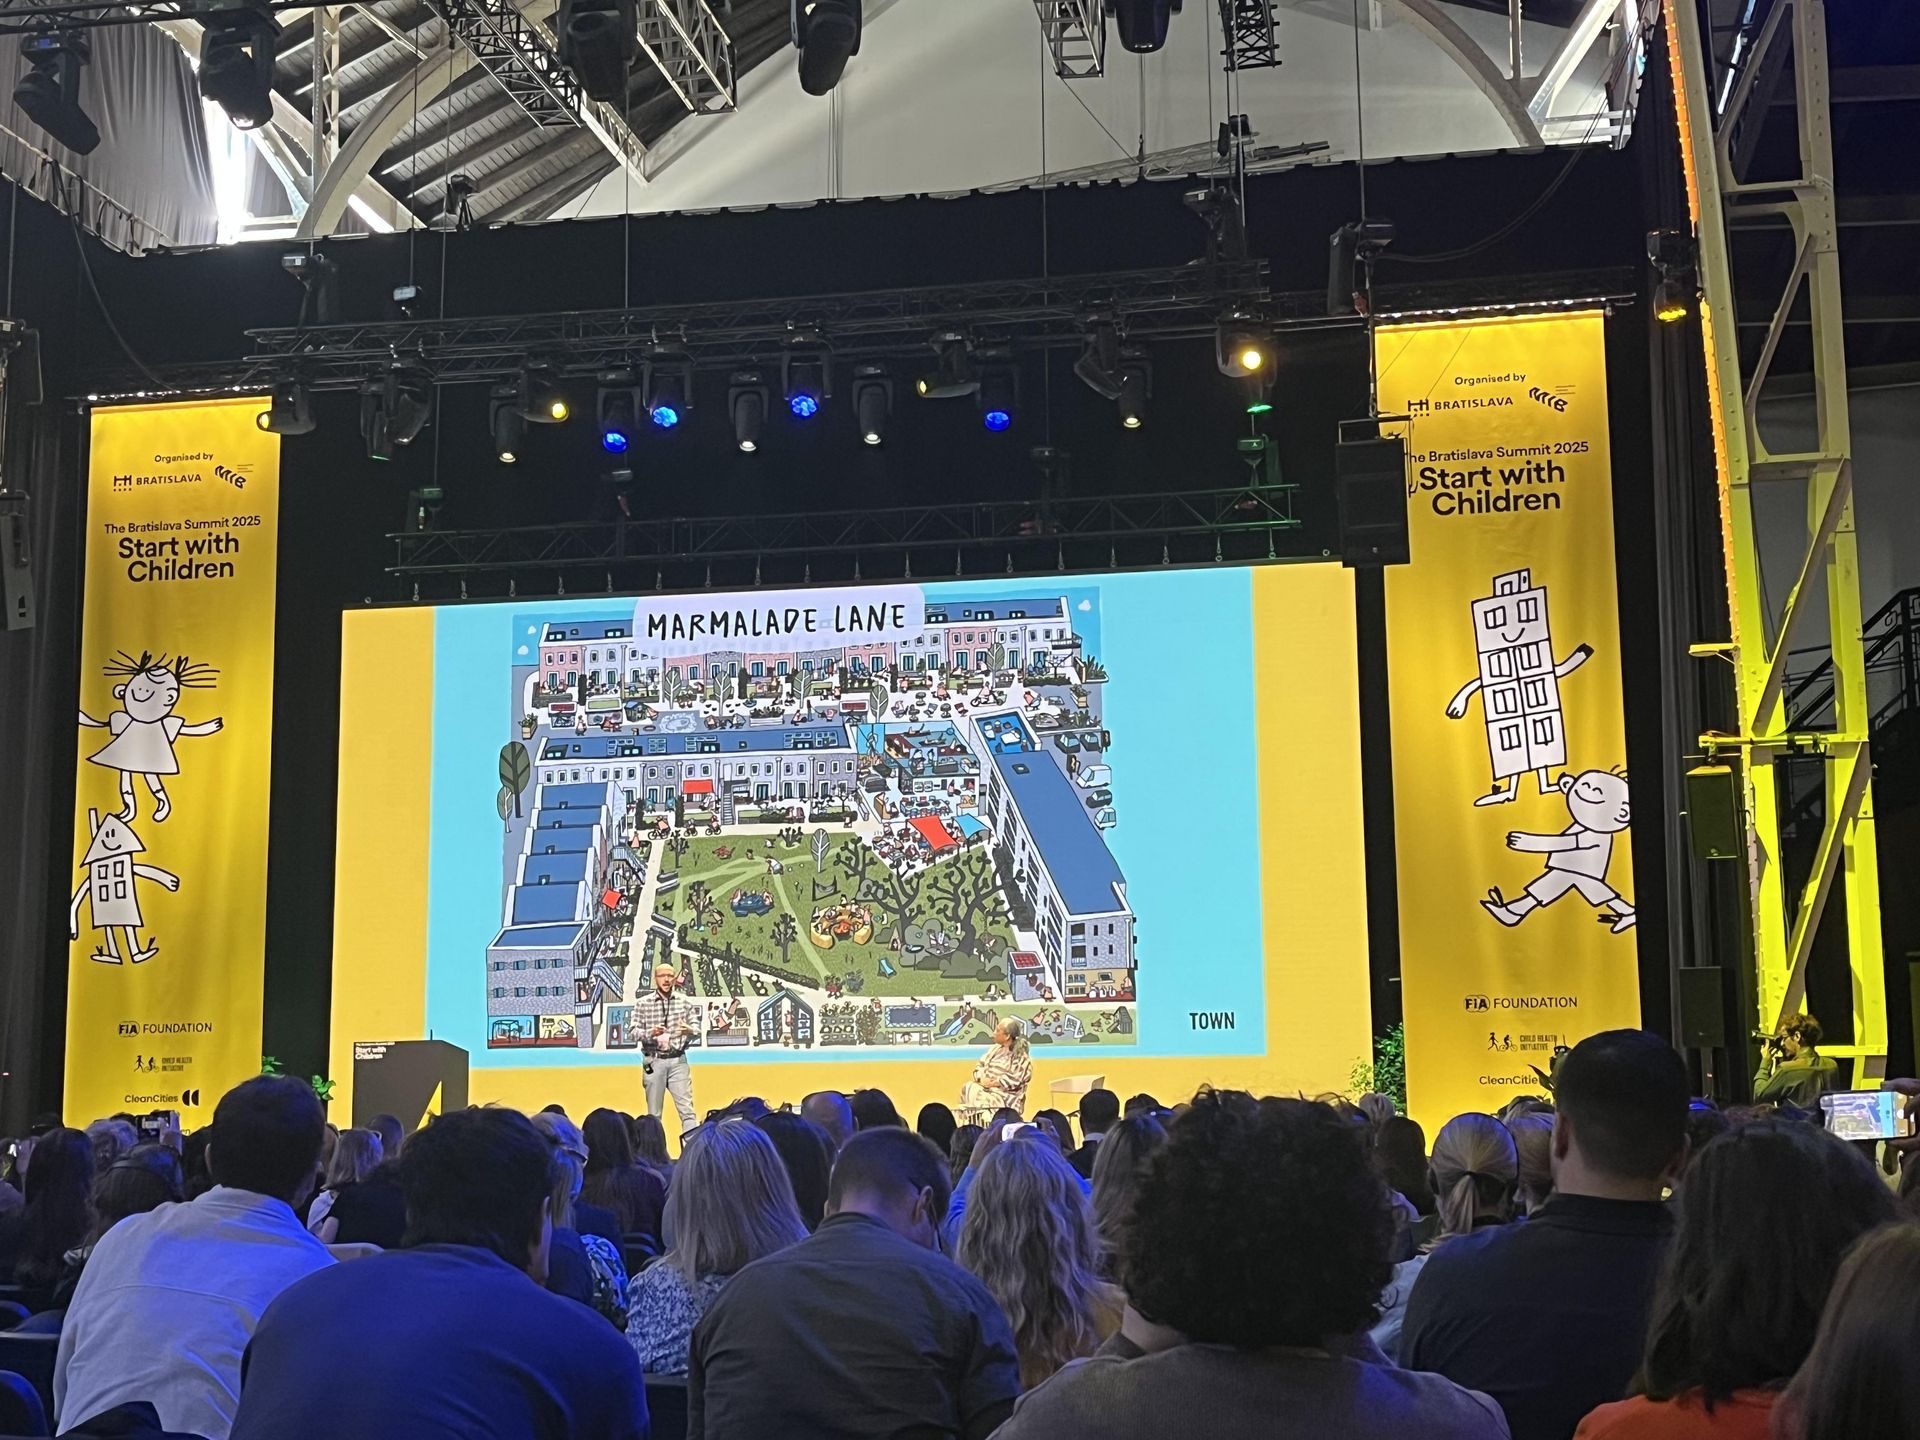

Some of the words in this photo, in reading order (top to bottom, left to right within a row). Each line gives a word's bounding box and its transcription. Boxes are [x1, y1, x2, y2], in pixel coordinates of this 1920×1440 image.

[1454, 373, 1511, 386] Organised
[1513, 373, 1526, 383] by
[1434, 396, 1514, 410] BRATISLAVA
[154, 453, 201, 464] Organised
[203, 452, 214, 462] by
[1410, 452, 1426, 463] he
[1429, 449, 1493, 461] Bratislava
[1496, 444, 1551, 458] Summit
[1554, 441, 1589, 454] 2025
[136, 474, 202, 486] BRATISLAVA
[1419, 466, 1492, 491] Start
[1499, 459, 1565, 485] with
[1432, 489, 1561, 516] Children
[104, 524, 126, 534] The
[128, 521, 182, 533] Bratislava
[184, 518, 230, 530] Summit
[232, 515, 261, 527] 2025
[118, 537, 179, 559] Start
[185, 532, 239, 555] with
[127, 558, 235, 583] Children
[648, 607, 817, 642] MARMALADE
[835, 602, 905, 633] LANE
[1464, 997, 1489, 1010] FIA
[1493, 996, 1578, 1009] FOUNDATION
[118, 1023, 138, 1035] FIA
[143, 1022, 212, 1034] FOUNDATION
[1189, 1011, 1235, 1030] TOWN
[1479, 1074, 1539, 1085] CleanCitie
[124, 1094, 178, 1104] CleanCities
